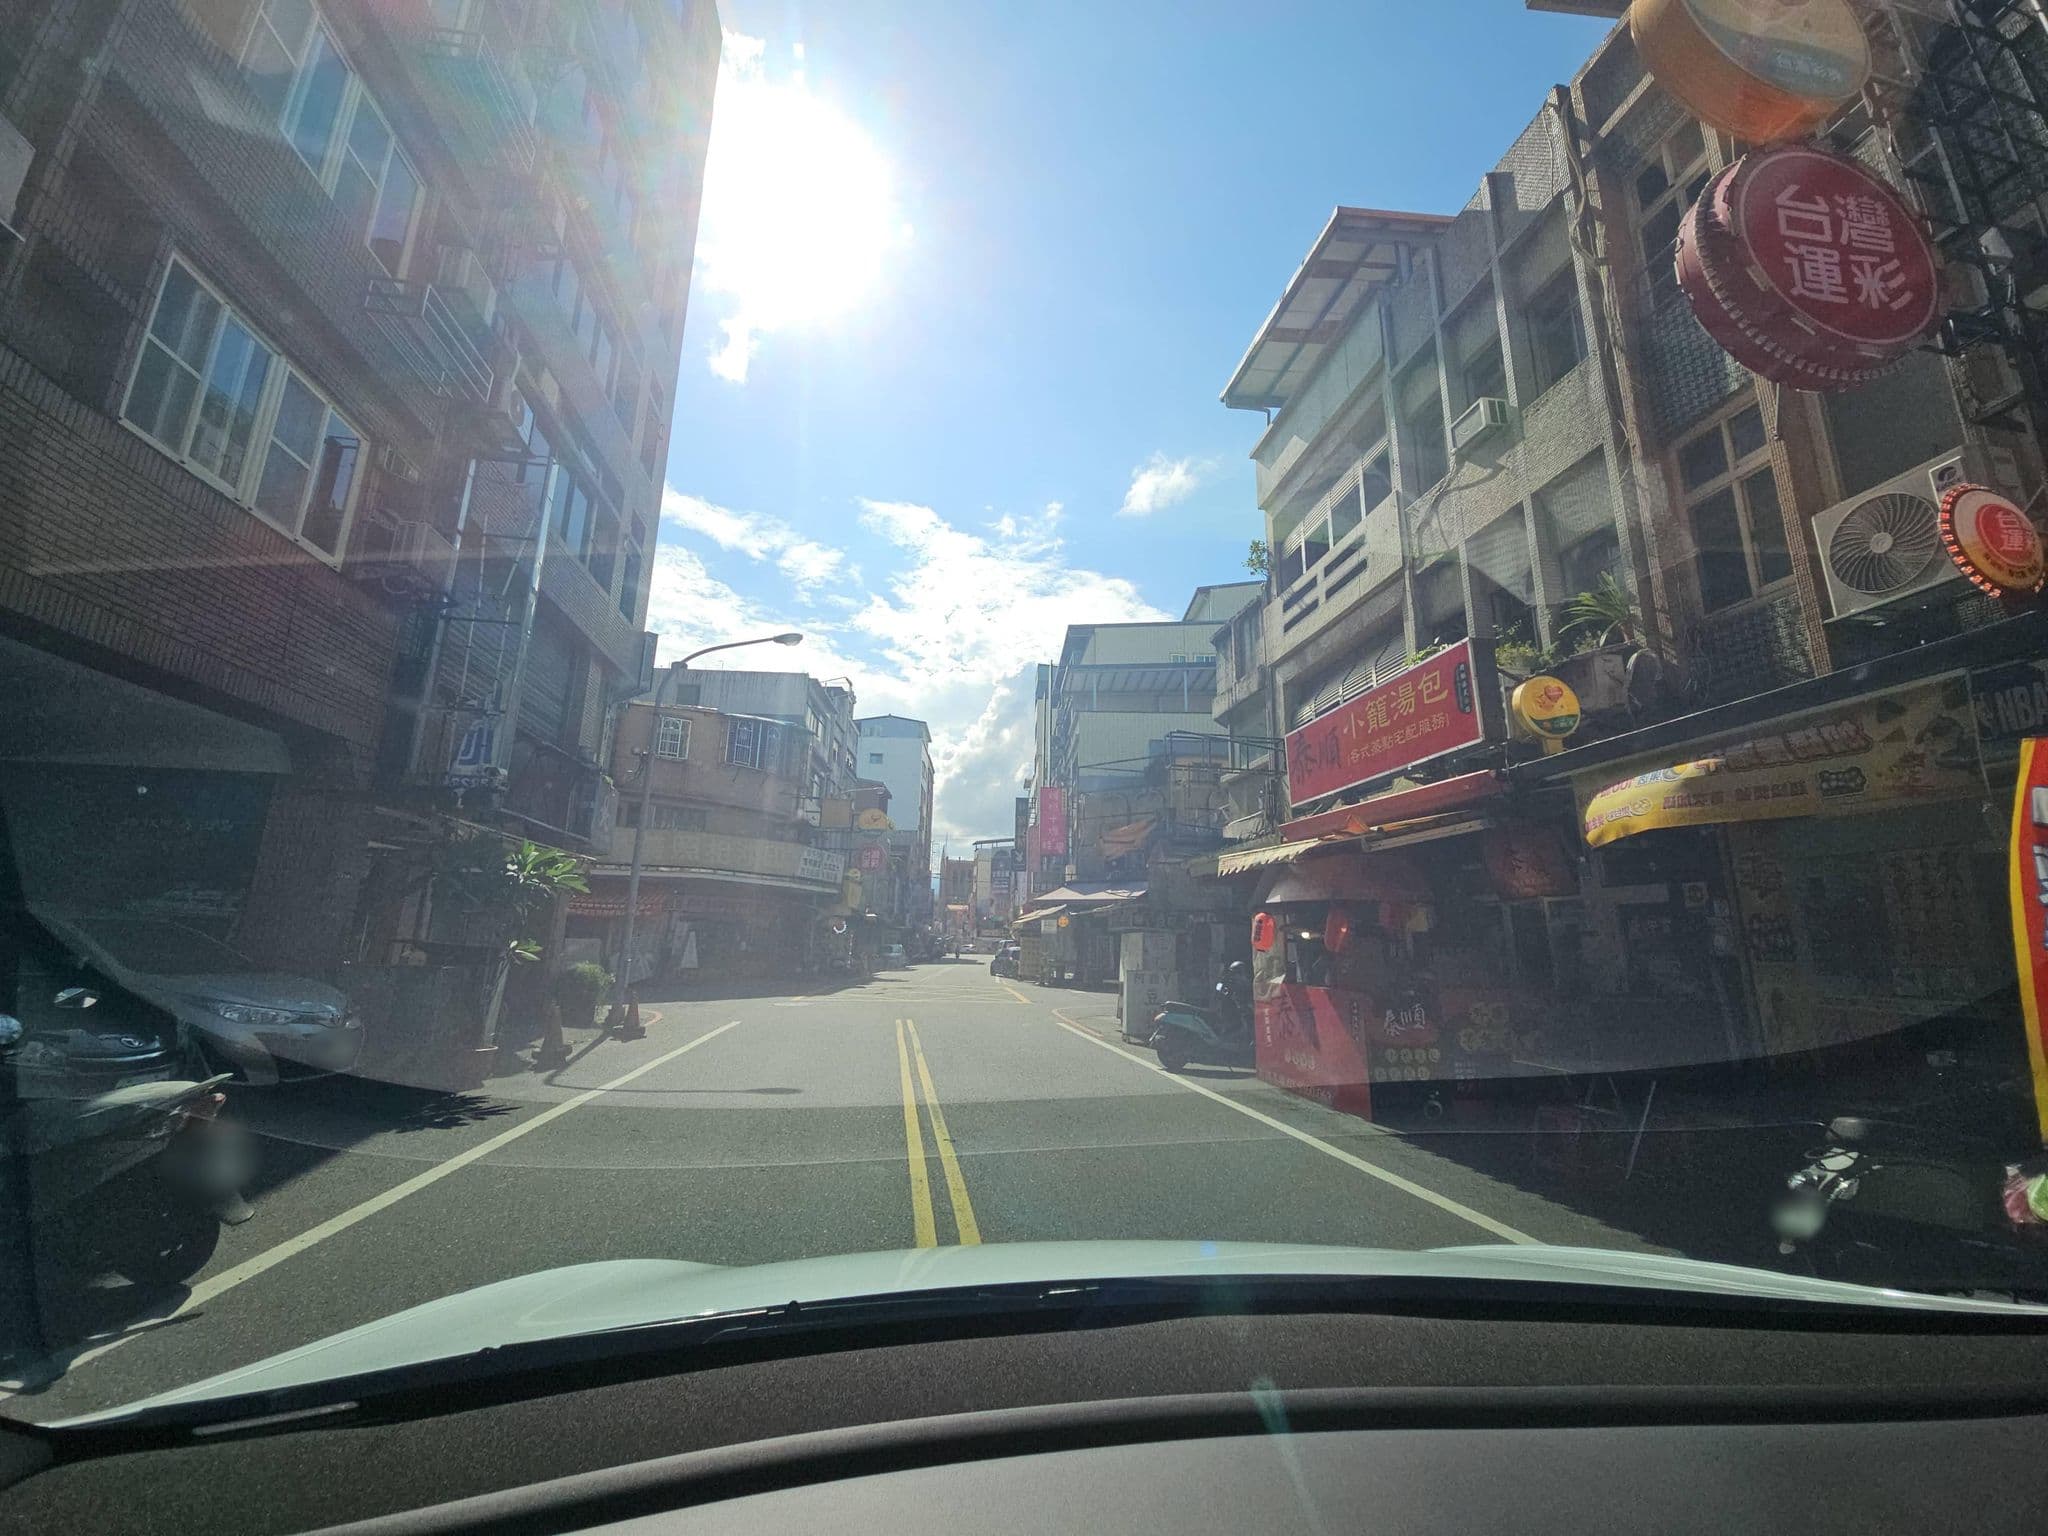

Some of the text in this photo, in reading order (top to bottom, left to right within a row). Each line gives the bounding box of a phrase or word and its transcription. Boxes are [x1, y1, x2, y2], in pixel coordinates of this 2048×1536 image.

[1775, 184, 1895, 253] 台灣
[1783, 241, 1914, 311] 運彩
[1343, 669, 1449, 740] 小籠湯包
[1290, 723, 1342, 786] 泰順
